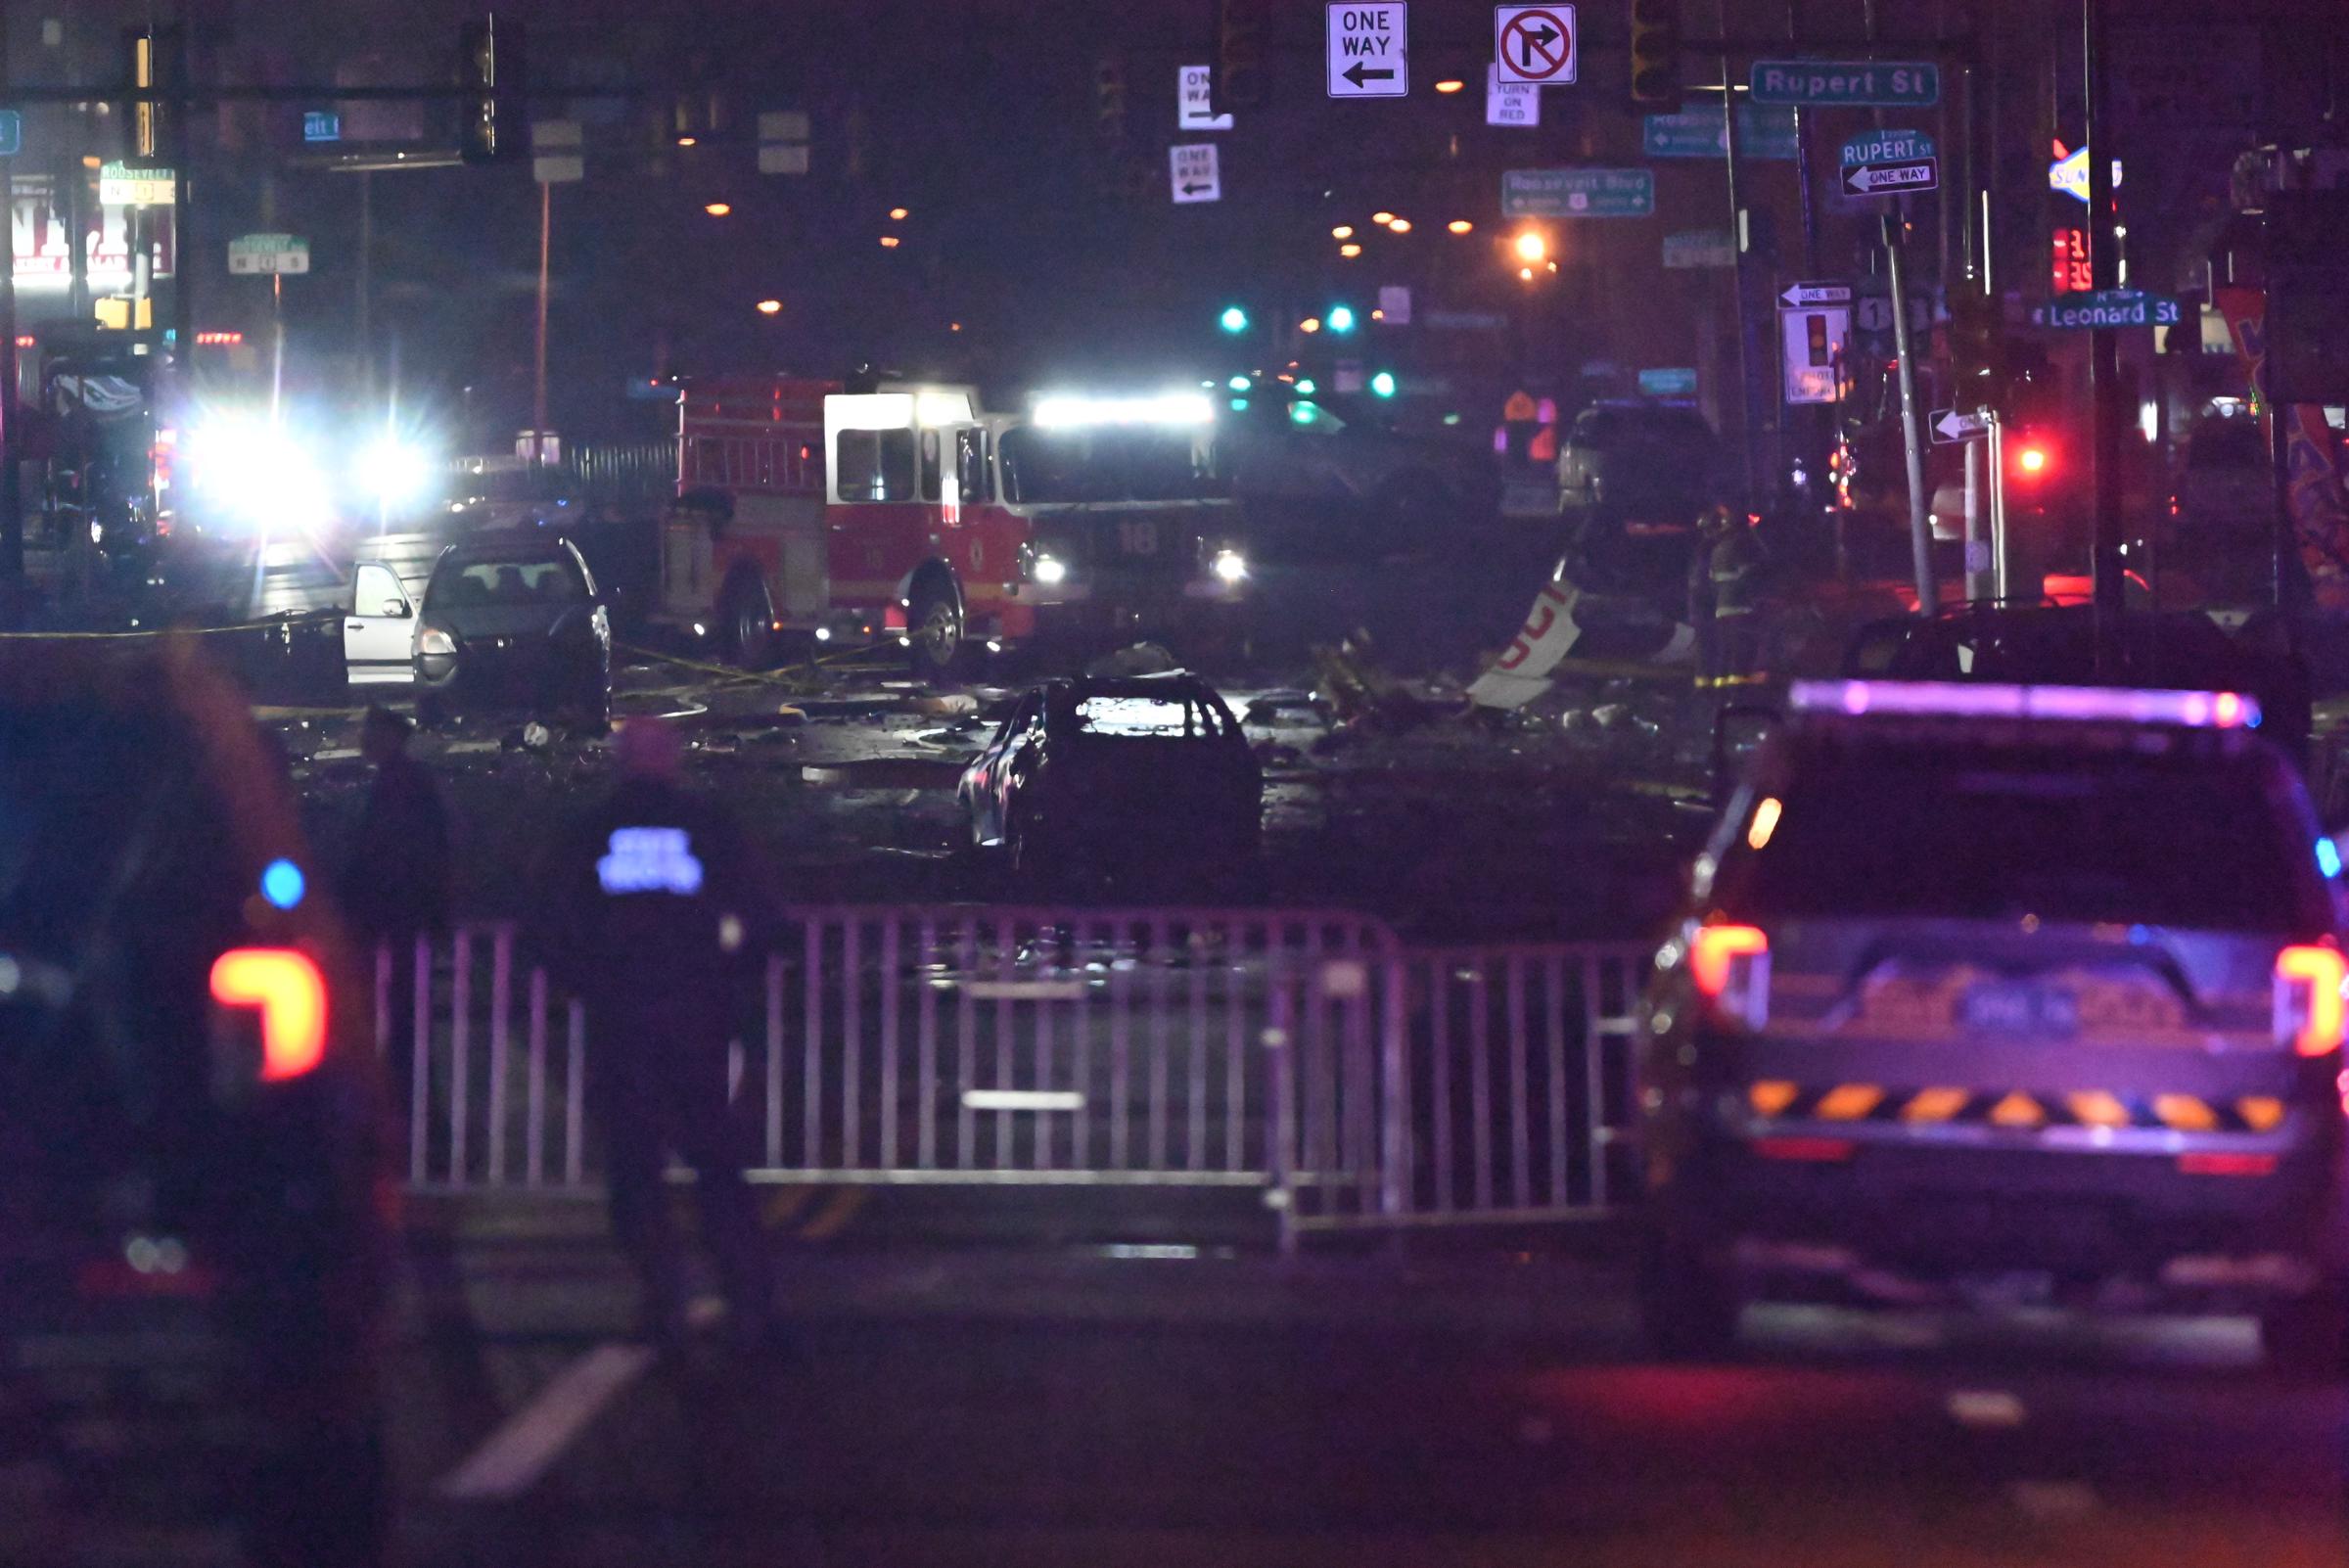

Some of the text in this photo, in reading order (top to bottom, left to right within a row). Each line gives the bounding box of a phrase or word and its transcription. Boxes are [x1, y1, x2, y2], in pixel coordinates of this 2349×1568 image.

[1343, 11, 1390, 31] ONE
[1343, 36, 1390, 56] WAY
[1186, 72, 1211, 85] ON
[1765, 69, 1924, 97] Rupert St
[1186, 90, 1211, 102] WA
[1503, 97, 1522, 108] ON
[1498, 109, 1526, 120] RED
[1843, 138, 1916, 163] RUPERT
[1869, 167, 1927, 185] ONE WAY
[1800, 290, 1822, 301] ONE
[2050, 301, 2179, 327] Leonard St
